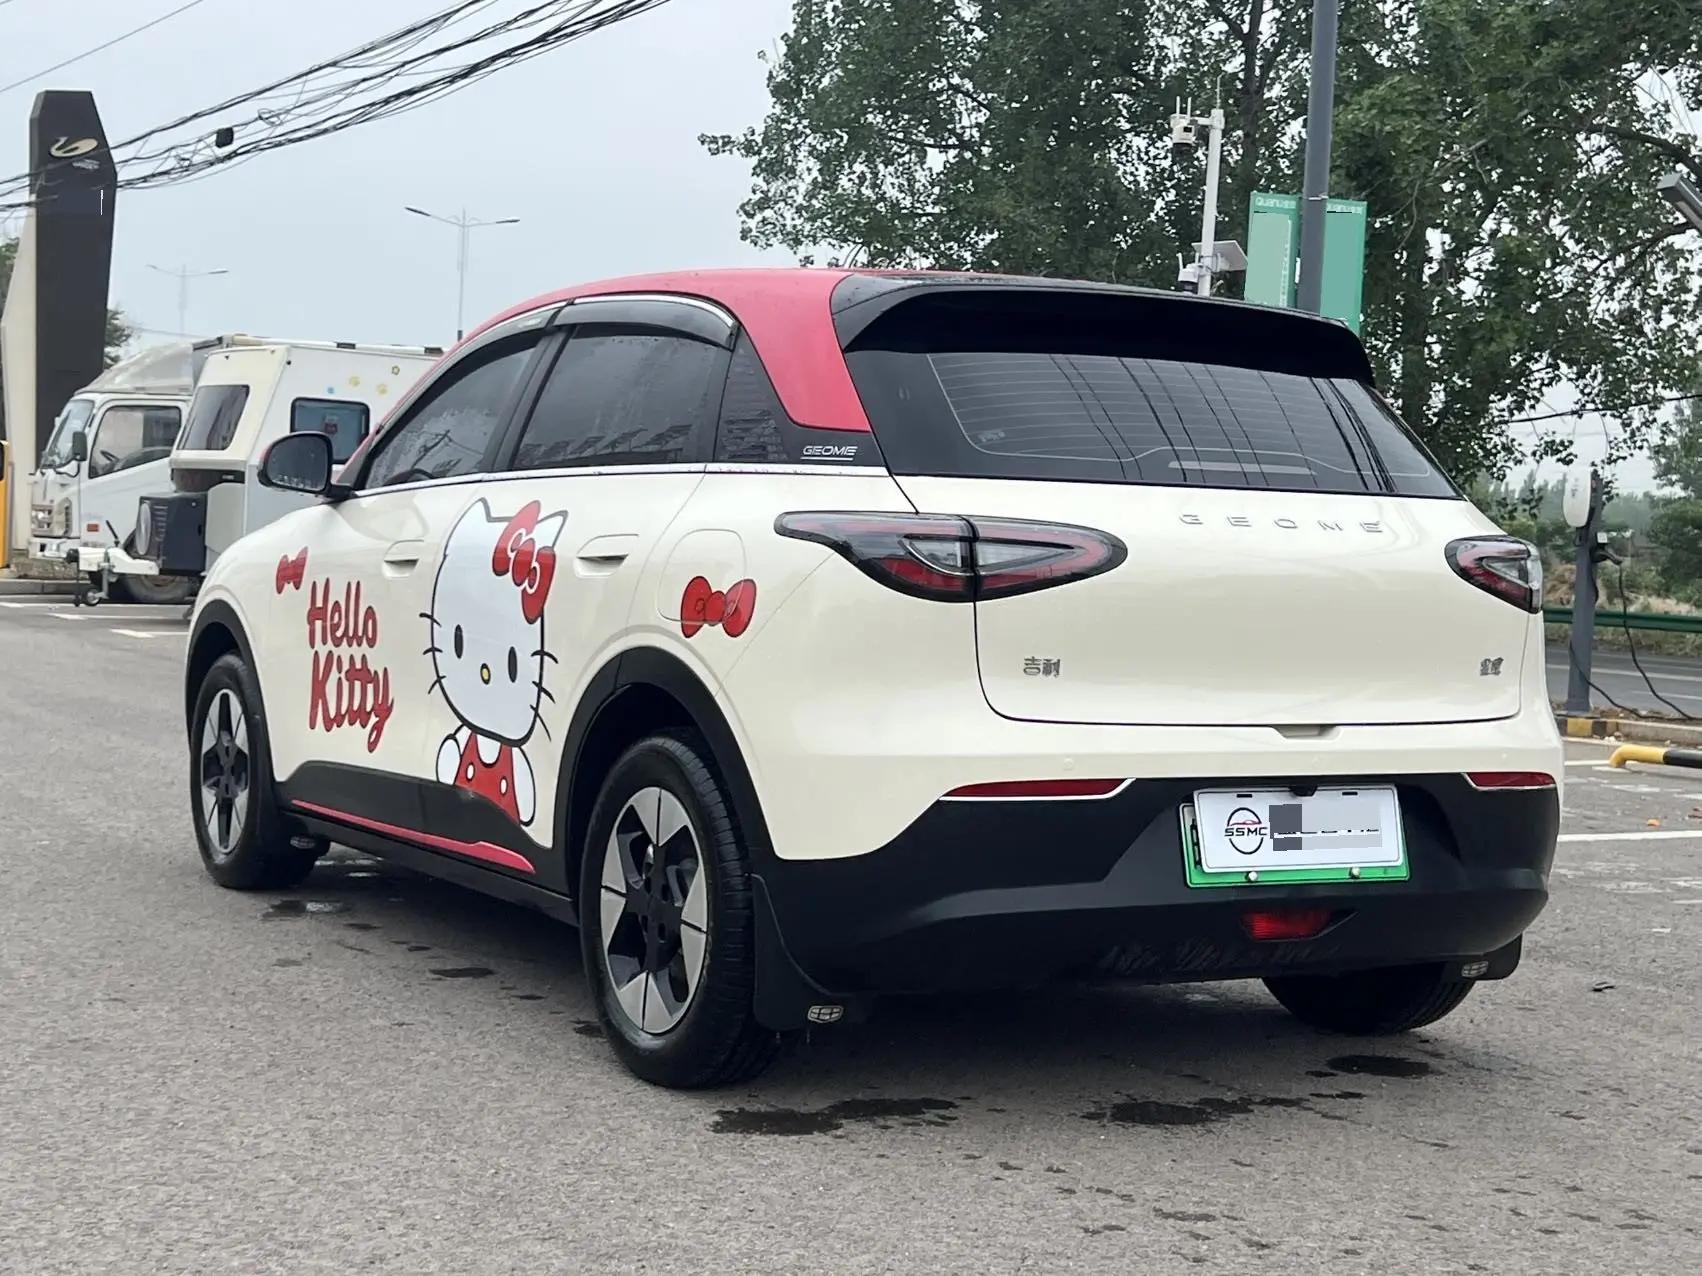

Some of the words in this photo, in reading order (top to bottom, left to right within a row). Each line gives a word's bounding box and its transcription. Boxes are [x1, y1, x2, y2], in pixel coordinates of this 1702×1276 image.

[802, 445, 858, 456] GEOME
[1179, 514, 1384, 533] GEOME
[306, 577, 378, 649] Hello
[1023, 656, 1061, 678] 吉利
[309, 650, 394, 754] Kitty
[1224, 826, 1269, 837] SSMC
